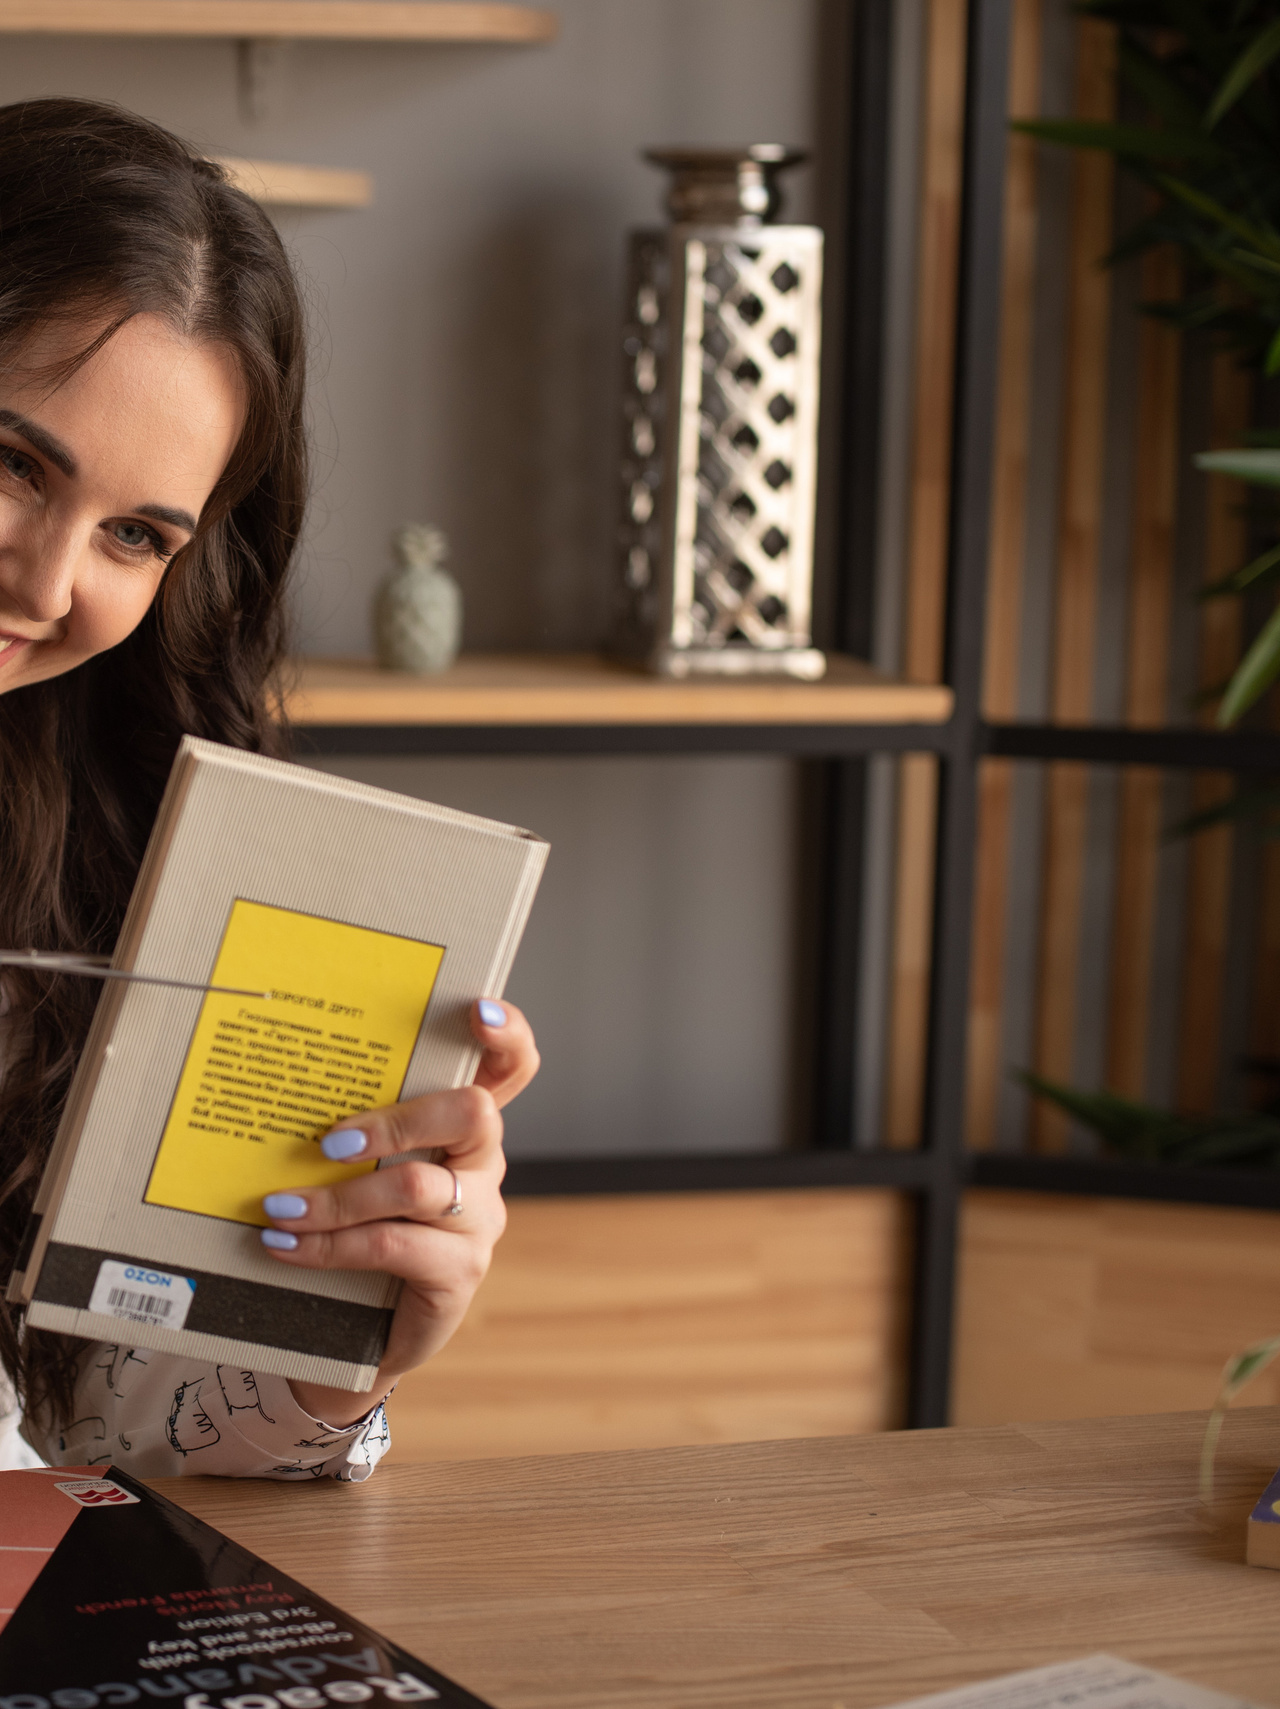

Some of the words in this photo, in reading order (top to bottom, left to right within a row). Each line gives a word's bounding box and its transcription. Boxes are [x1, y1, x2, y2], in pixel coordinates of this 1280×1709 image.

[124, 1267, 172, 1288] OZON
[177, 1612, 270, 1632] Edition
[270, 1606, 316, 1620] 3rd
[199, 1630, 250, 1649] and
[253, 1621, 336, 1639] eBook
[147, 1638, 199, 1655] key
[202, 1631, 354, 1661] coursebook
[138, 1650, 200, 1671] with
